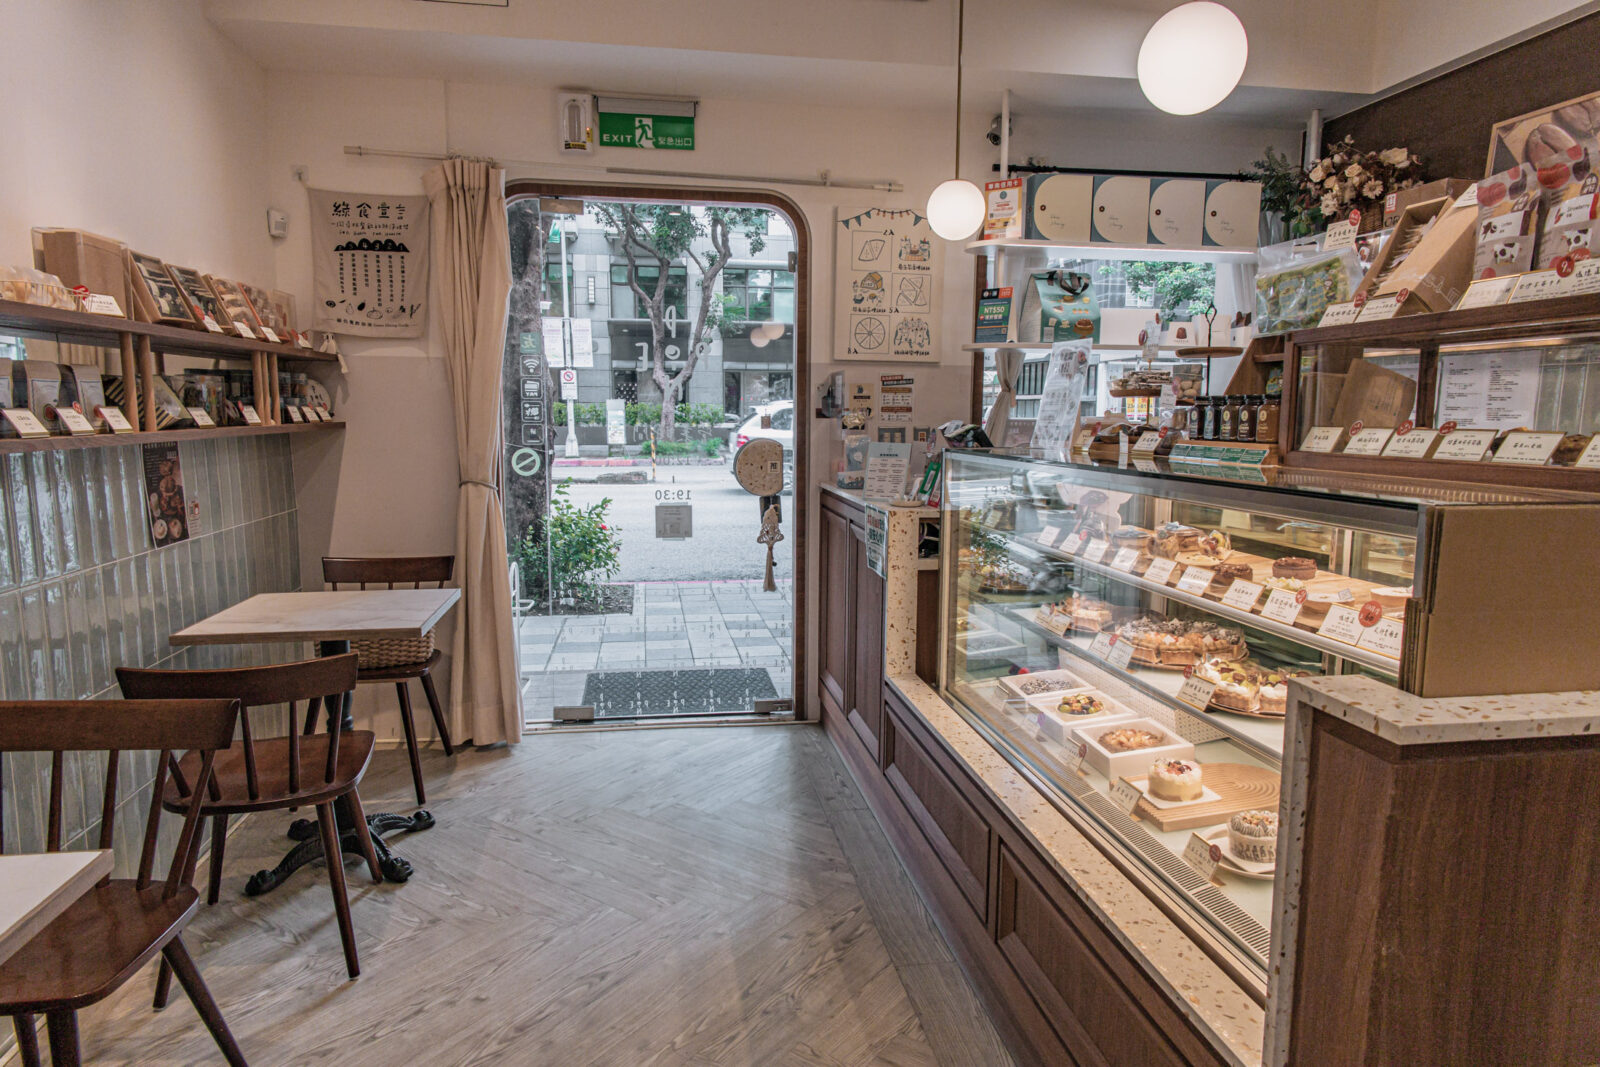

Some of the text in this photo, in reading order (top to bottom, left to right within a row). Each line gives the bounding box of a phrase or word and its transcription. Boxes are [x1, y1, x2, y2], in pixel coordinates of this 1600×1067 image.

[603, 134, 632, 143] EXIT
[658, 137, 692, 146] 緊急出口
[984, 306, 1005, 314] NT$50
